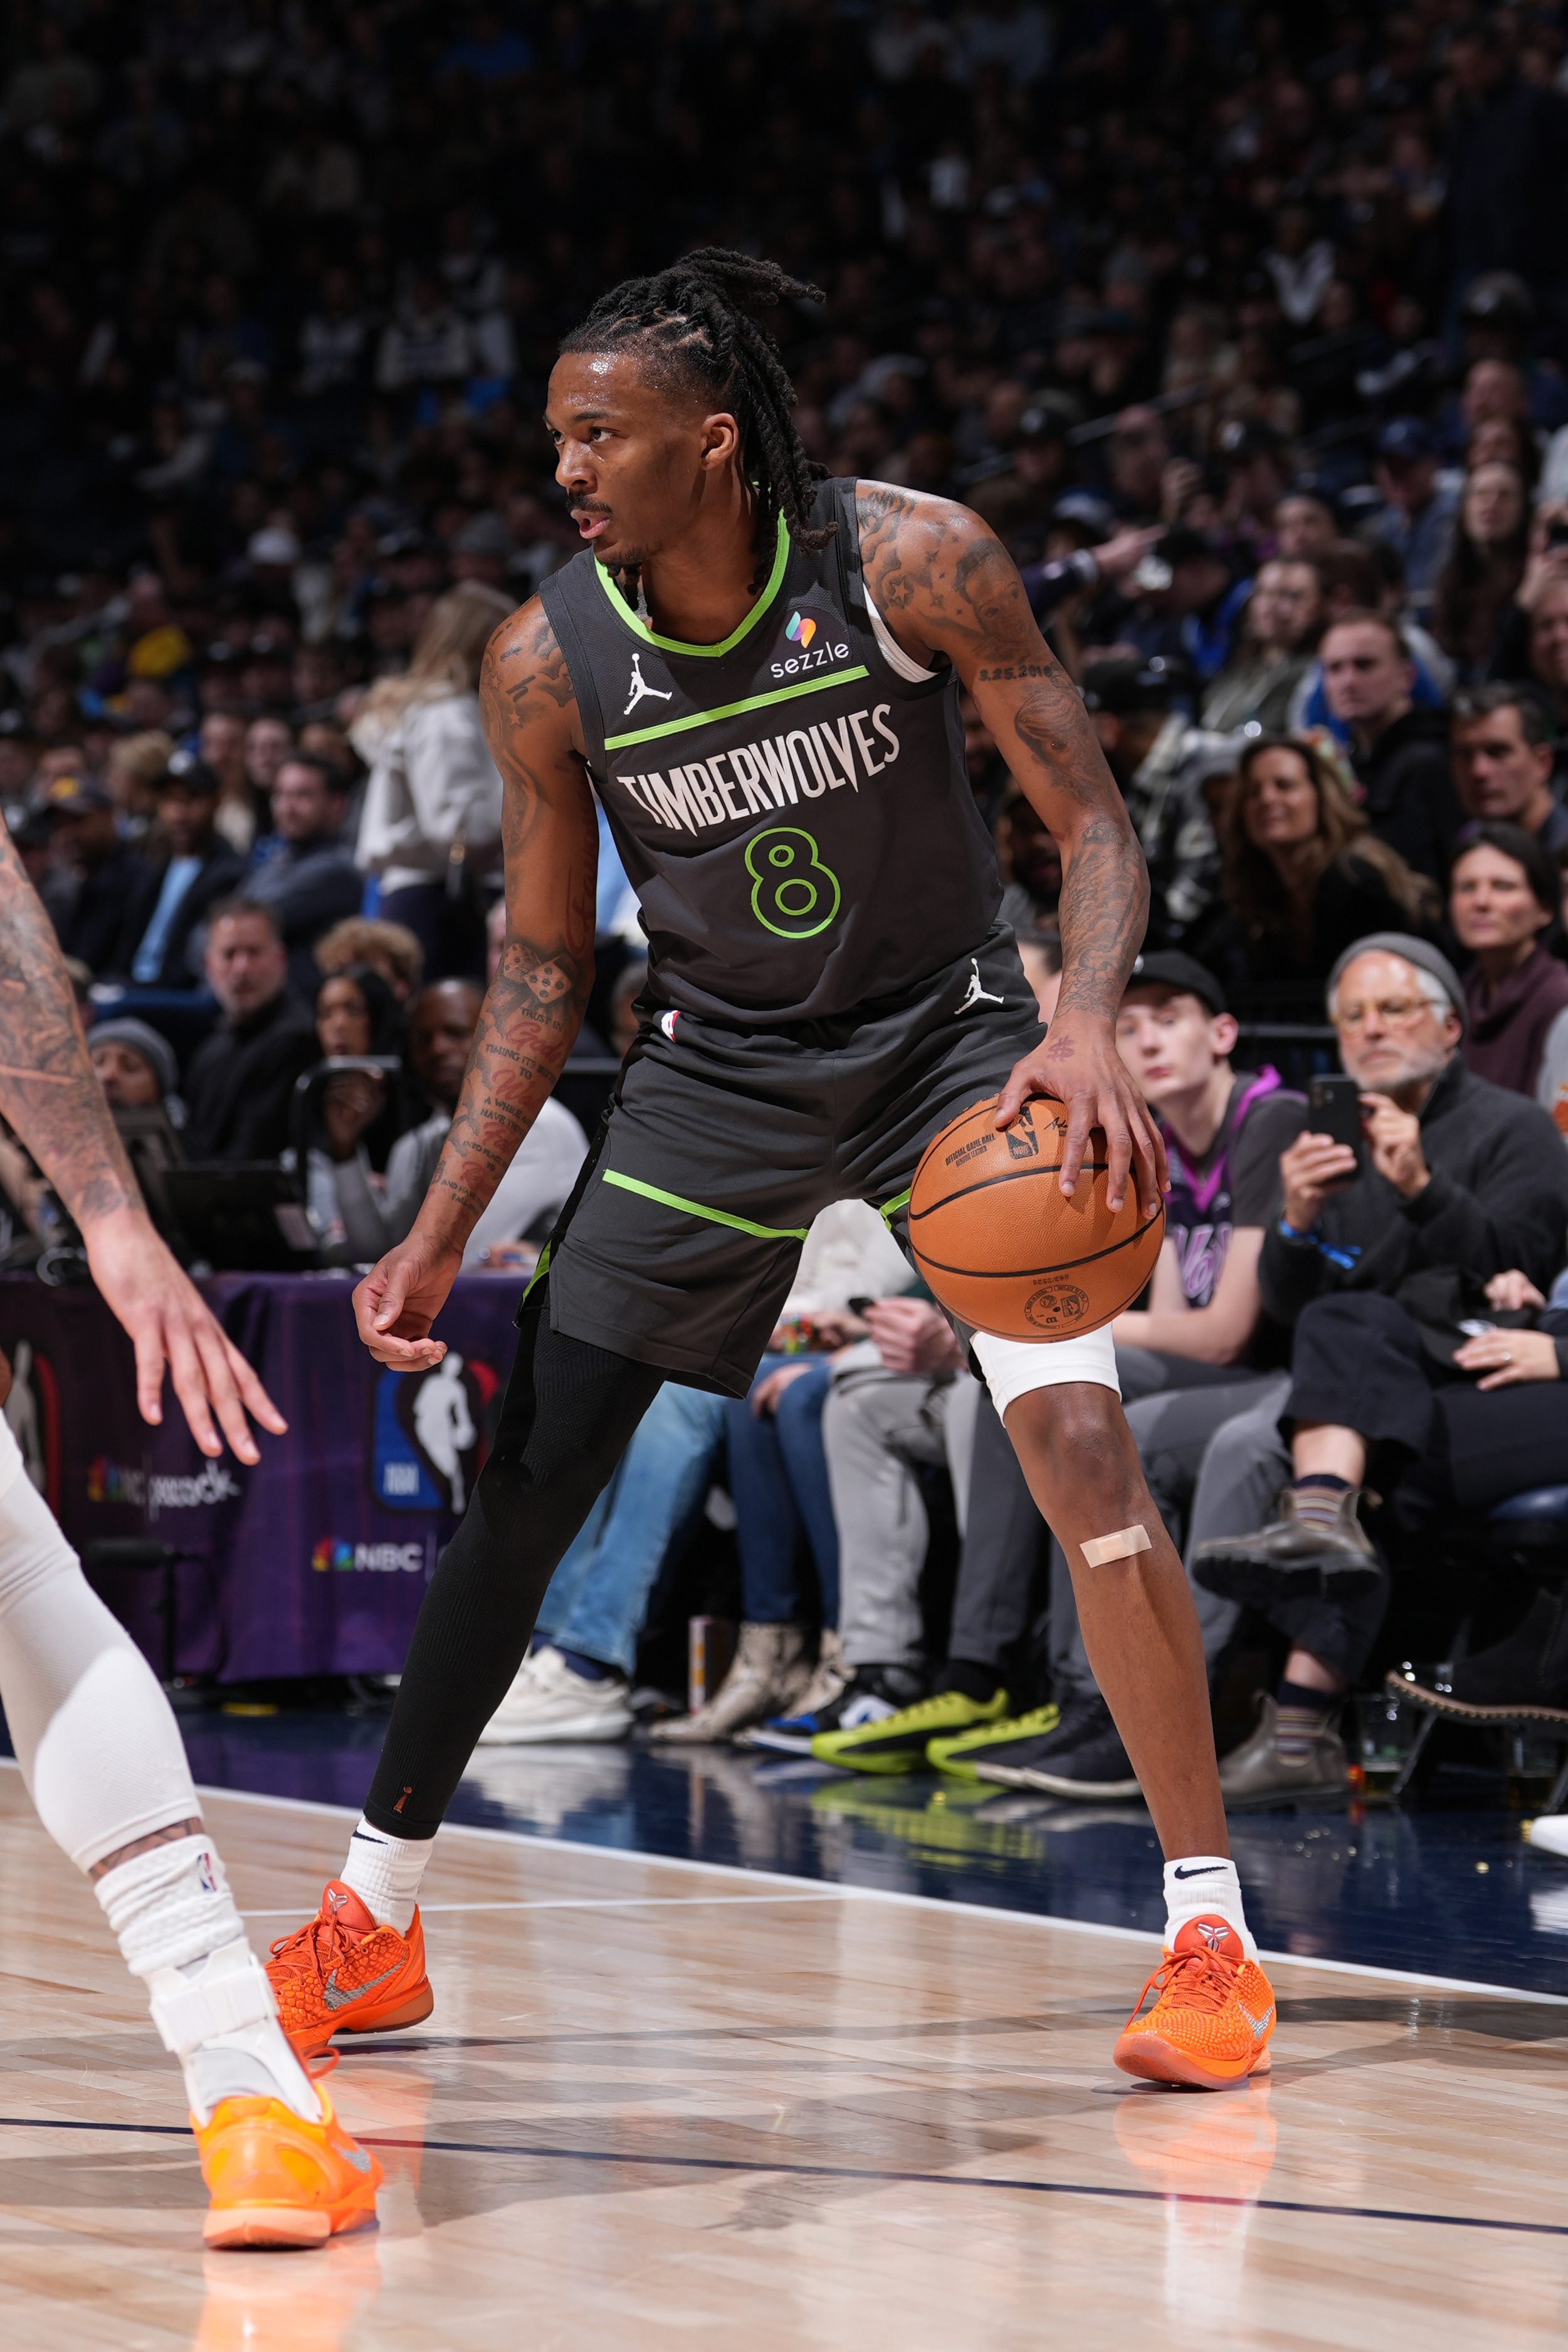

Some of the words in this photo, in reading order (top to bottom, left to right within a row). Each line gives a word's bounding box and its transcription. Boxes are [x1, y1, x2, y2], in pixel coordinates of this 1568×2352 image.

[770, 641, 850, 678] sezzle
[617, 704, 900, 837] TIMBERWOLVES
[744, 827, 841, 939] 8
[521, 1007, 552, 1025] TRUST
[485, 1043, 520, 1062] TIMING
[519, 1066, 532, 1080] TO
[480, 1108, 505, 1125] HAVE
[494, 1098, 522, 1119] WHILE
[945, 1146, 967, 1166] OFFICIAL
[966, 1138, 982, 1152] GAME
[981, 1132, 996, 1145] BALL
[354, 1541, 424, 1573] NBC
